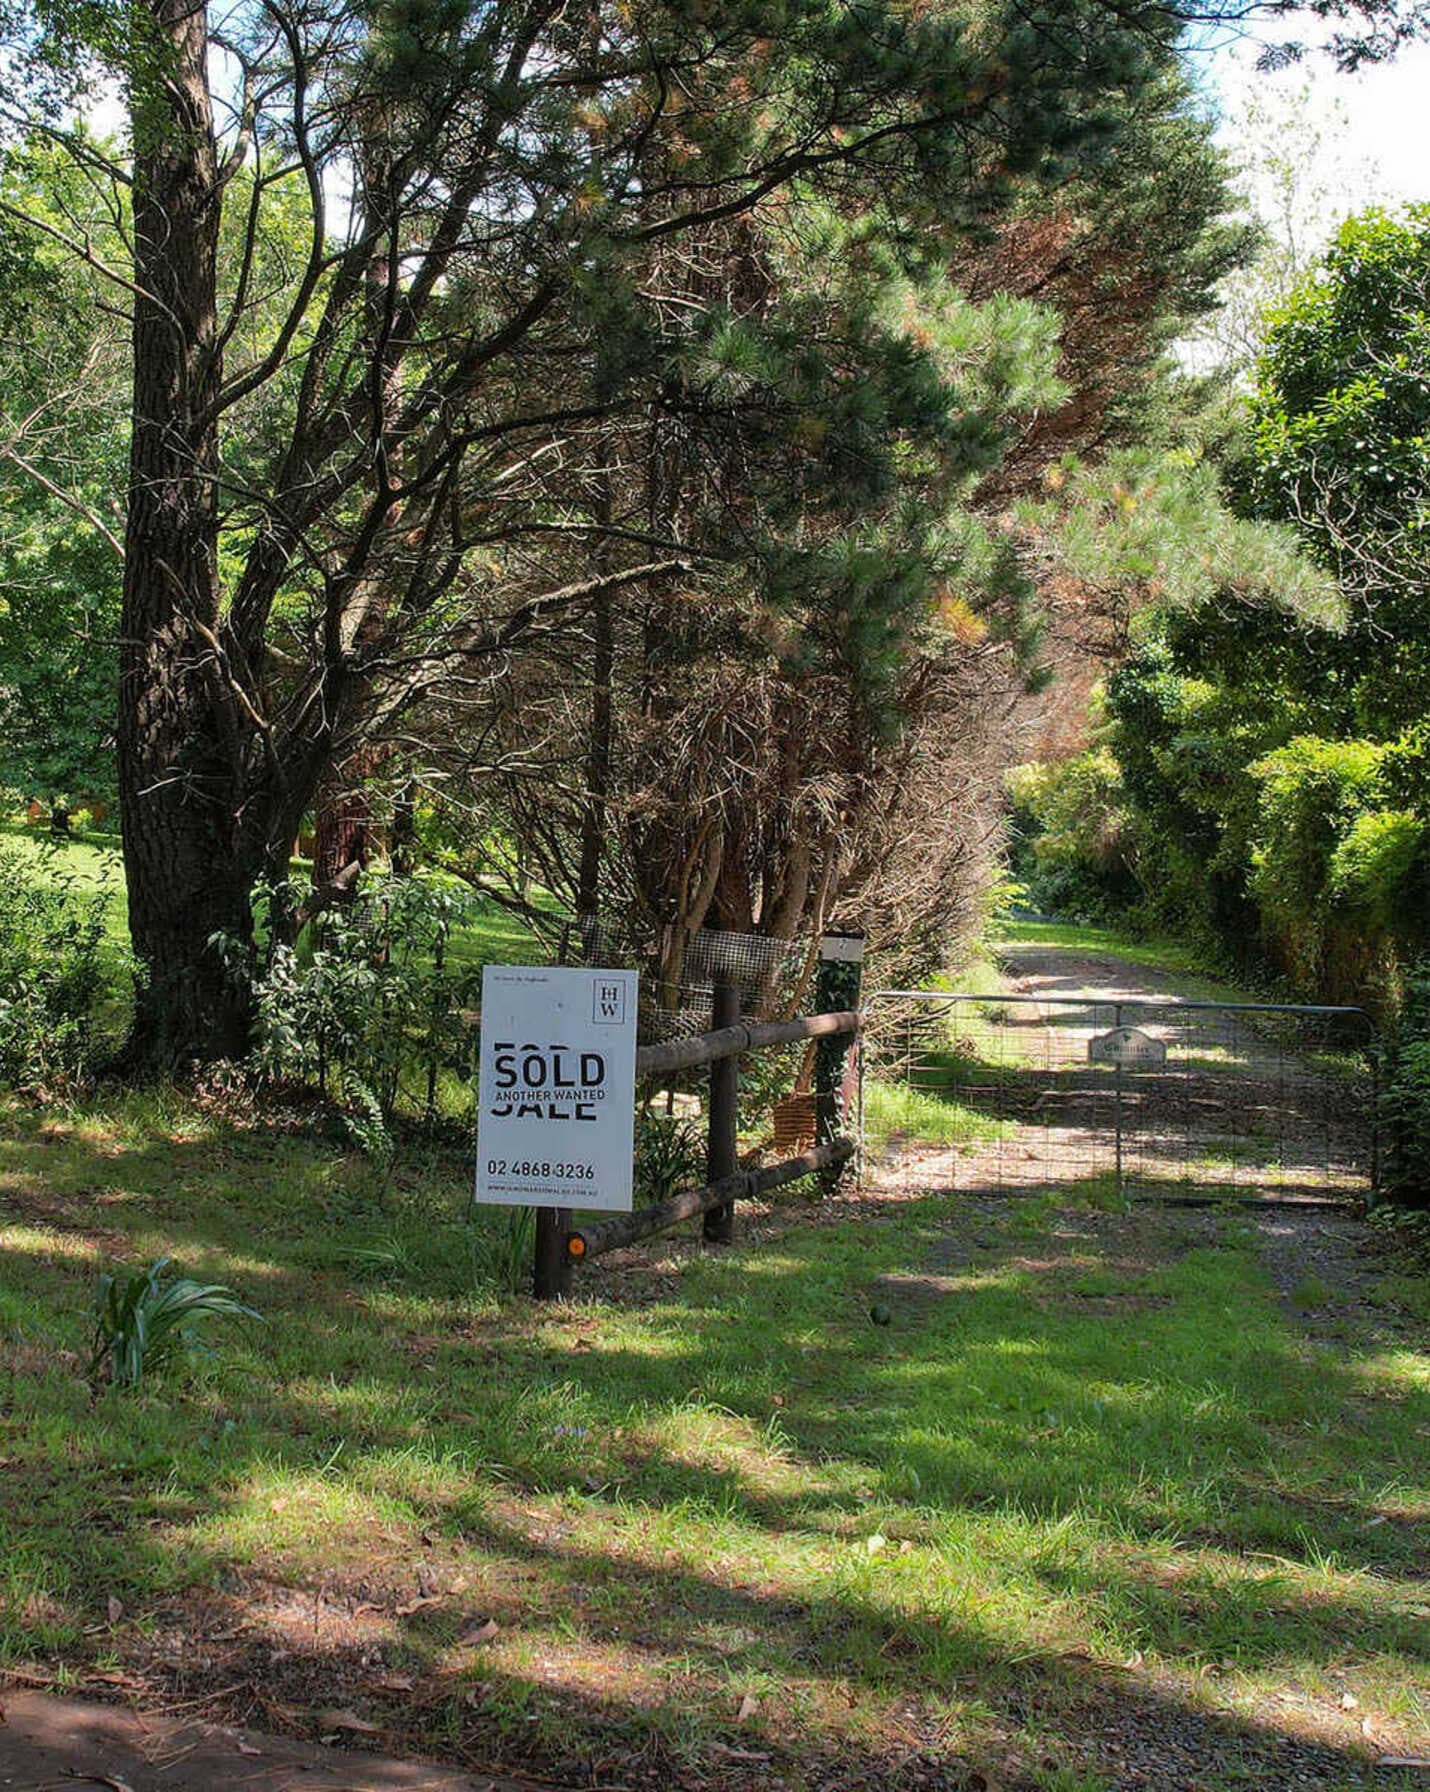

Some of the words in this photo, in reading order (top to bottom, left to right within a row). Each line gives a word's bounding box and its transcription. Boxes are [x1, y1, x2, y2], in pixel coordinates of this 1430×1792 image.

[601, 1003, 618, 1017] W
[495, 1053, 606, 1088] SOLD
[496, 1089, 551, 1102] ANOTHER
[554, 1088, 606, 1101] WANTED
[487, 1159, 507, 1176] 02
[511, 1160, 550, 1178] 4868
[555, 1163, 595, 1180] 3236
